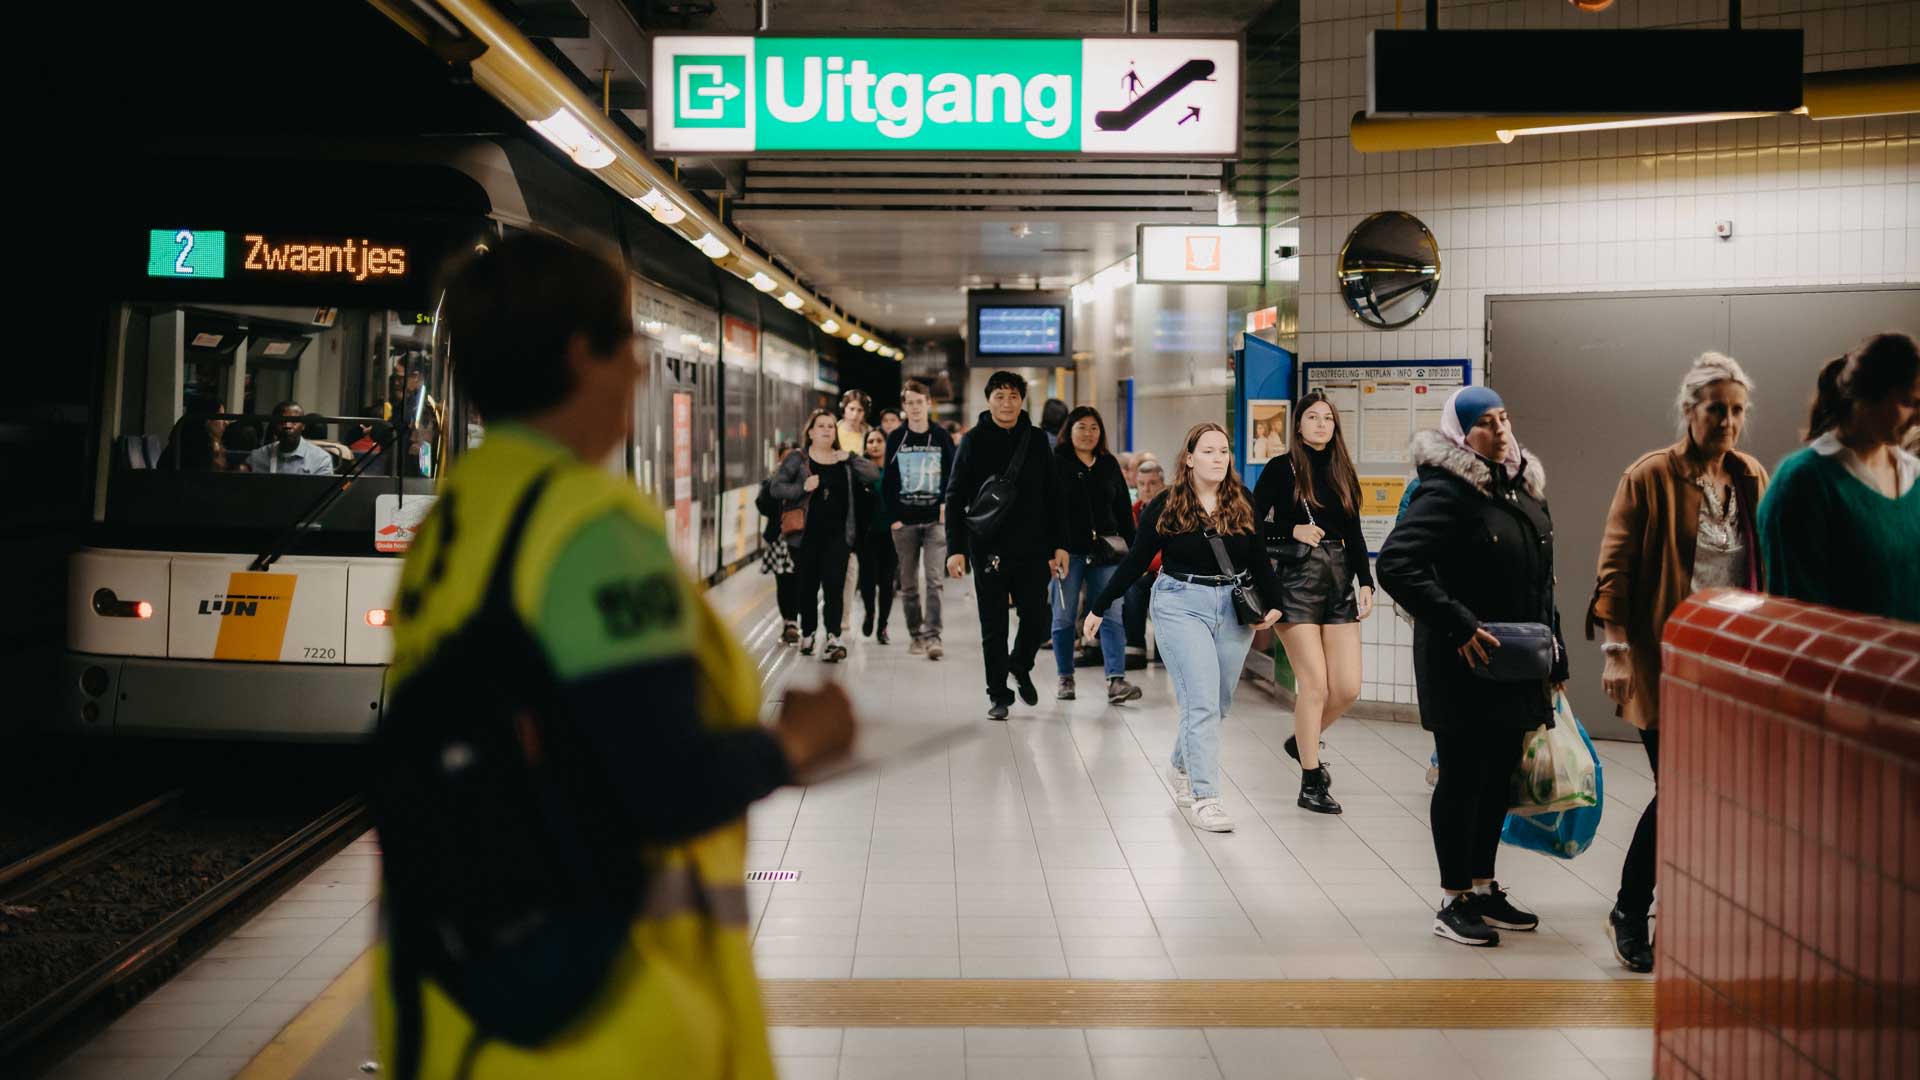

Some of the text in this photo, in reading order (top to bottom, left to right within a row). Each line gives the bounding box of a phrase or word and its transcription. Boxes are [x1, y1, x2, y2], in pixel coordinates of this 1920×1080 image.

[766, 56, 1072, 138] Uitgang
[175, 231, 405, 281] 2 Zwaantjes
[1310, 368, 1360, 378] DIENSTREGELING
[1365, 368, 1391, 378] NETPLAN
[1397, 368, 1412, 377] INFO
[303, 647, 336, 660] 7220
